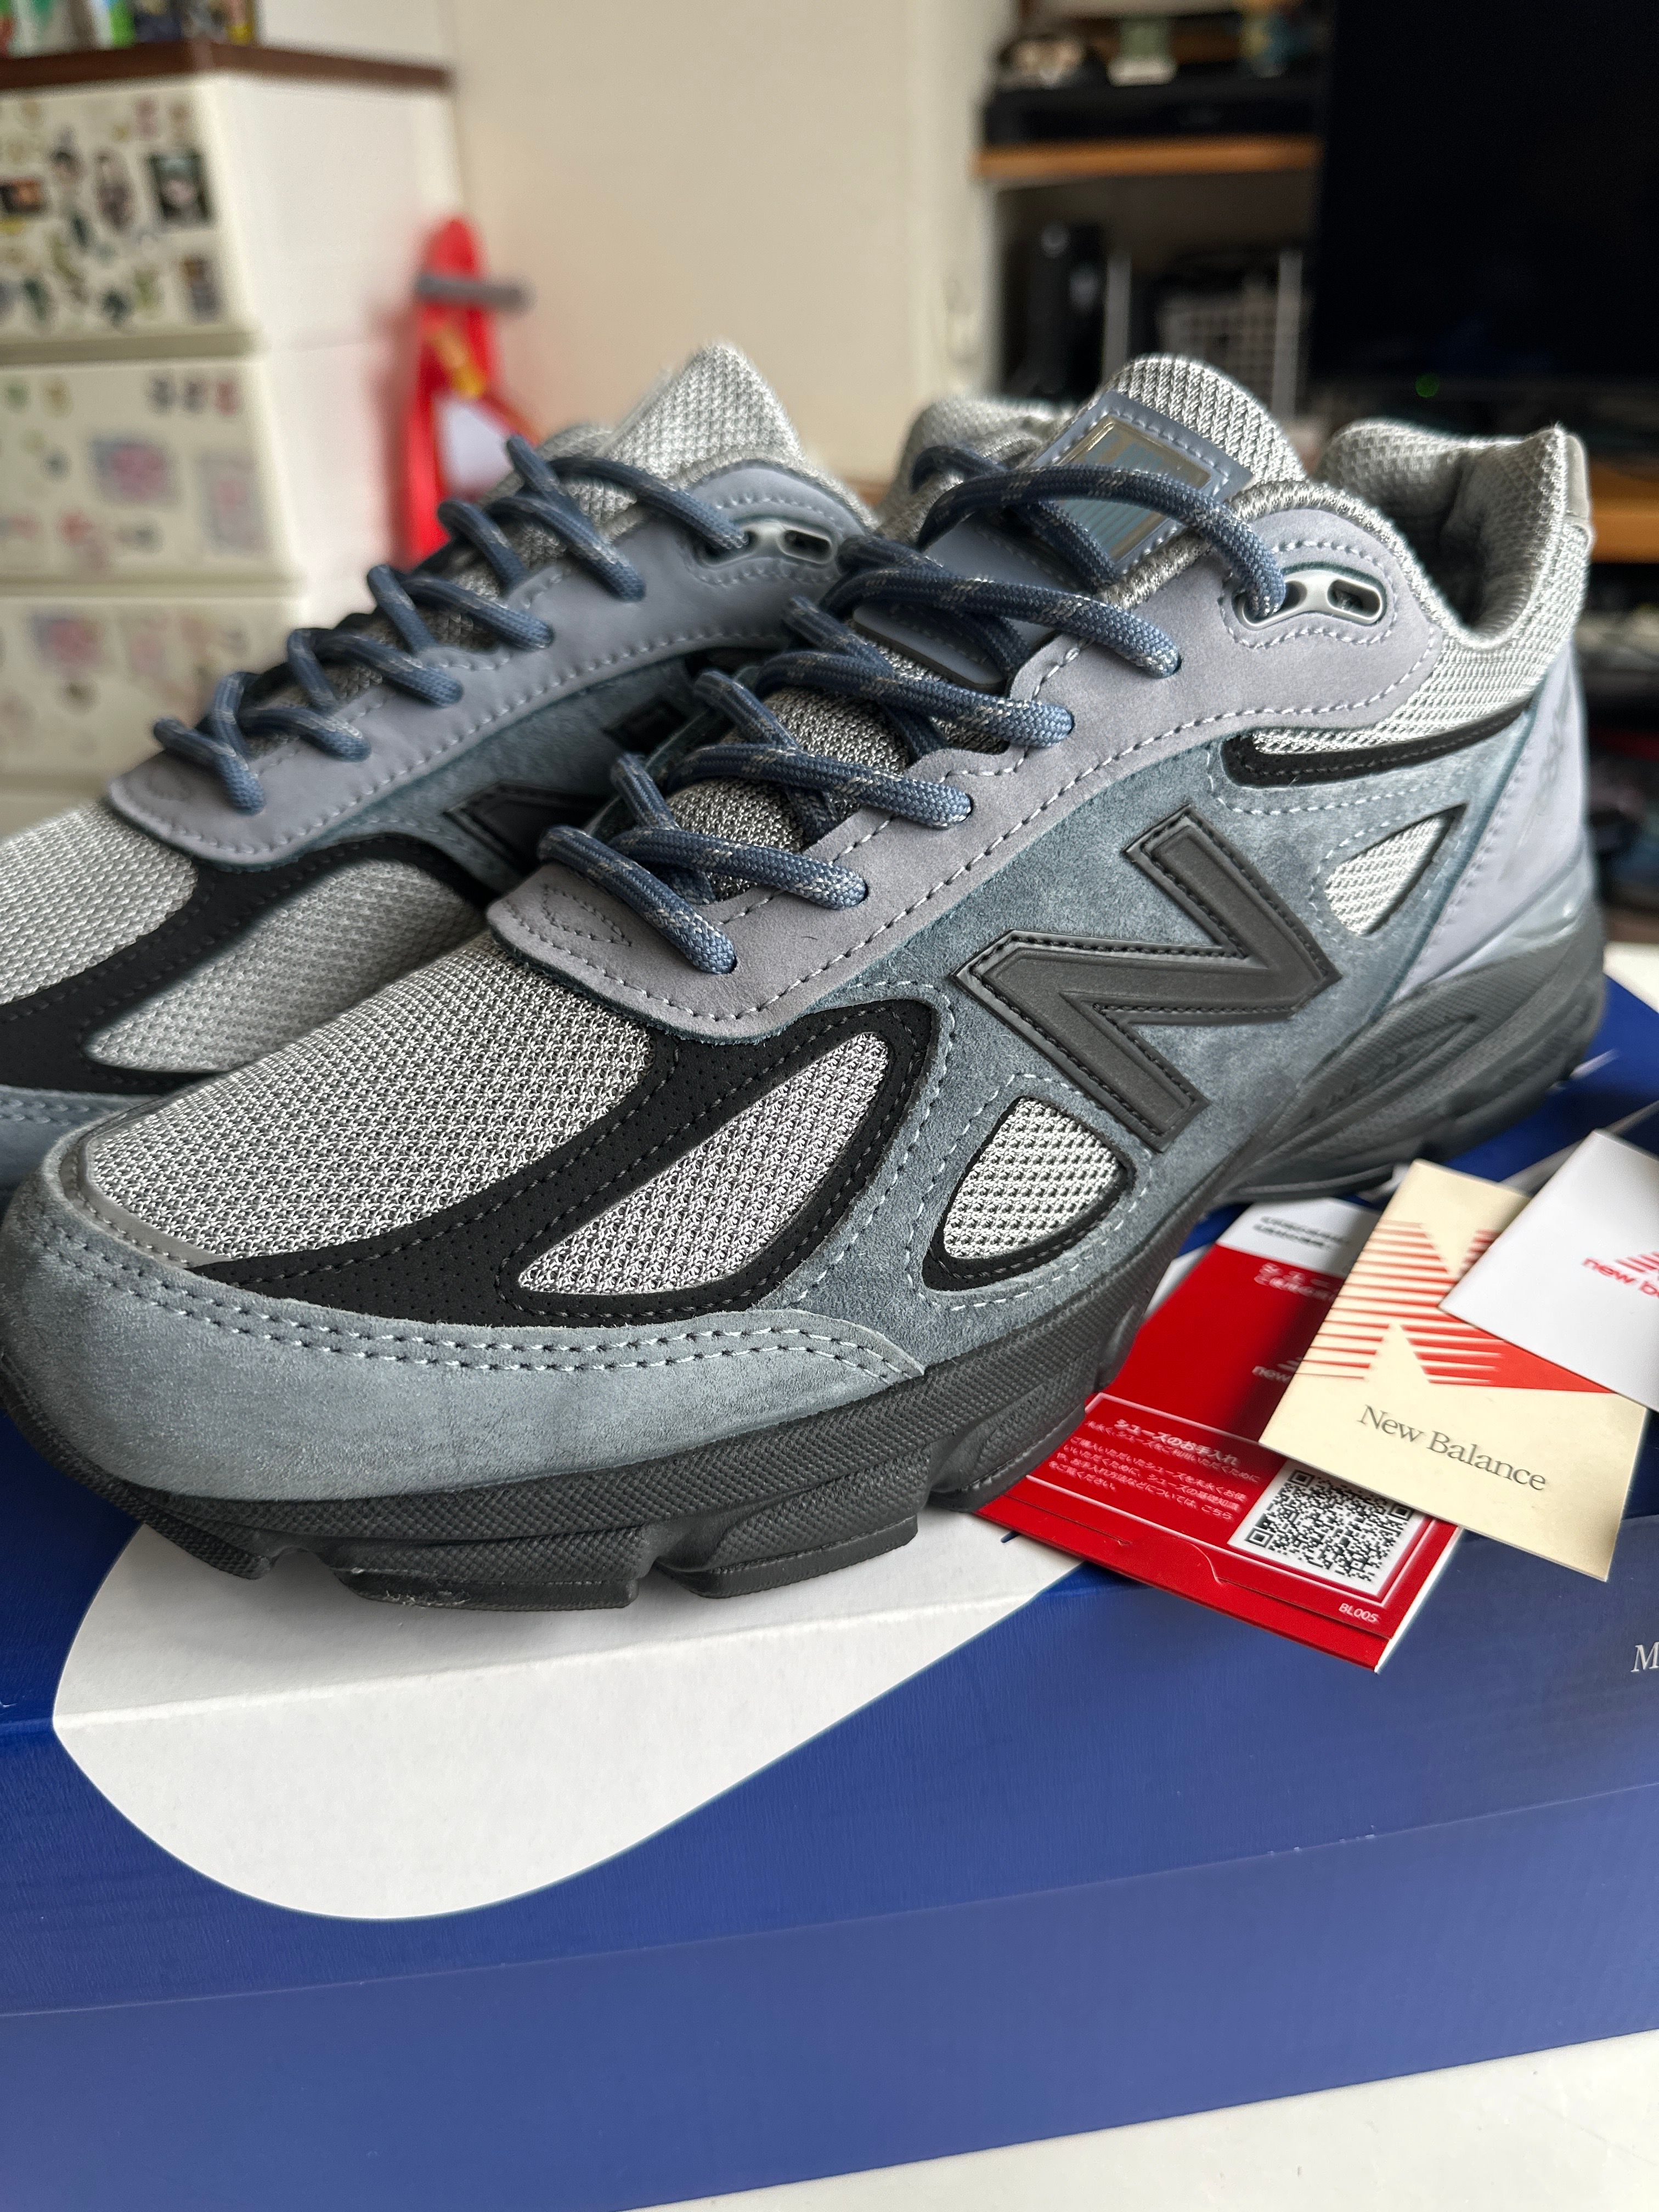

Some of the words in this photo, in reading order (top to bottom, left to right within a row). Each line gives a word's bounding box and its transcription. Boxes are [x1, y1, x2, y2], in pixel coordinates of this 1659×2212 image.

[1582, 1257, 1635, 1283] new
[1639, 1280, 1659, 1299] b
[1115, 1419, 1242, 1465] シューズのお手入れ
[1357, 1404, 1424, 1442] New
[1426, 1430, 1546, 1491] Balance
[1339, 1602, 1380, 1623] BL005
